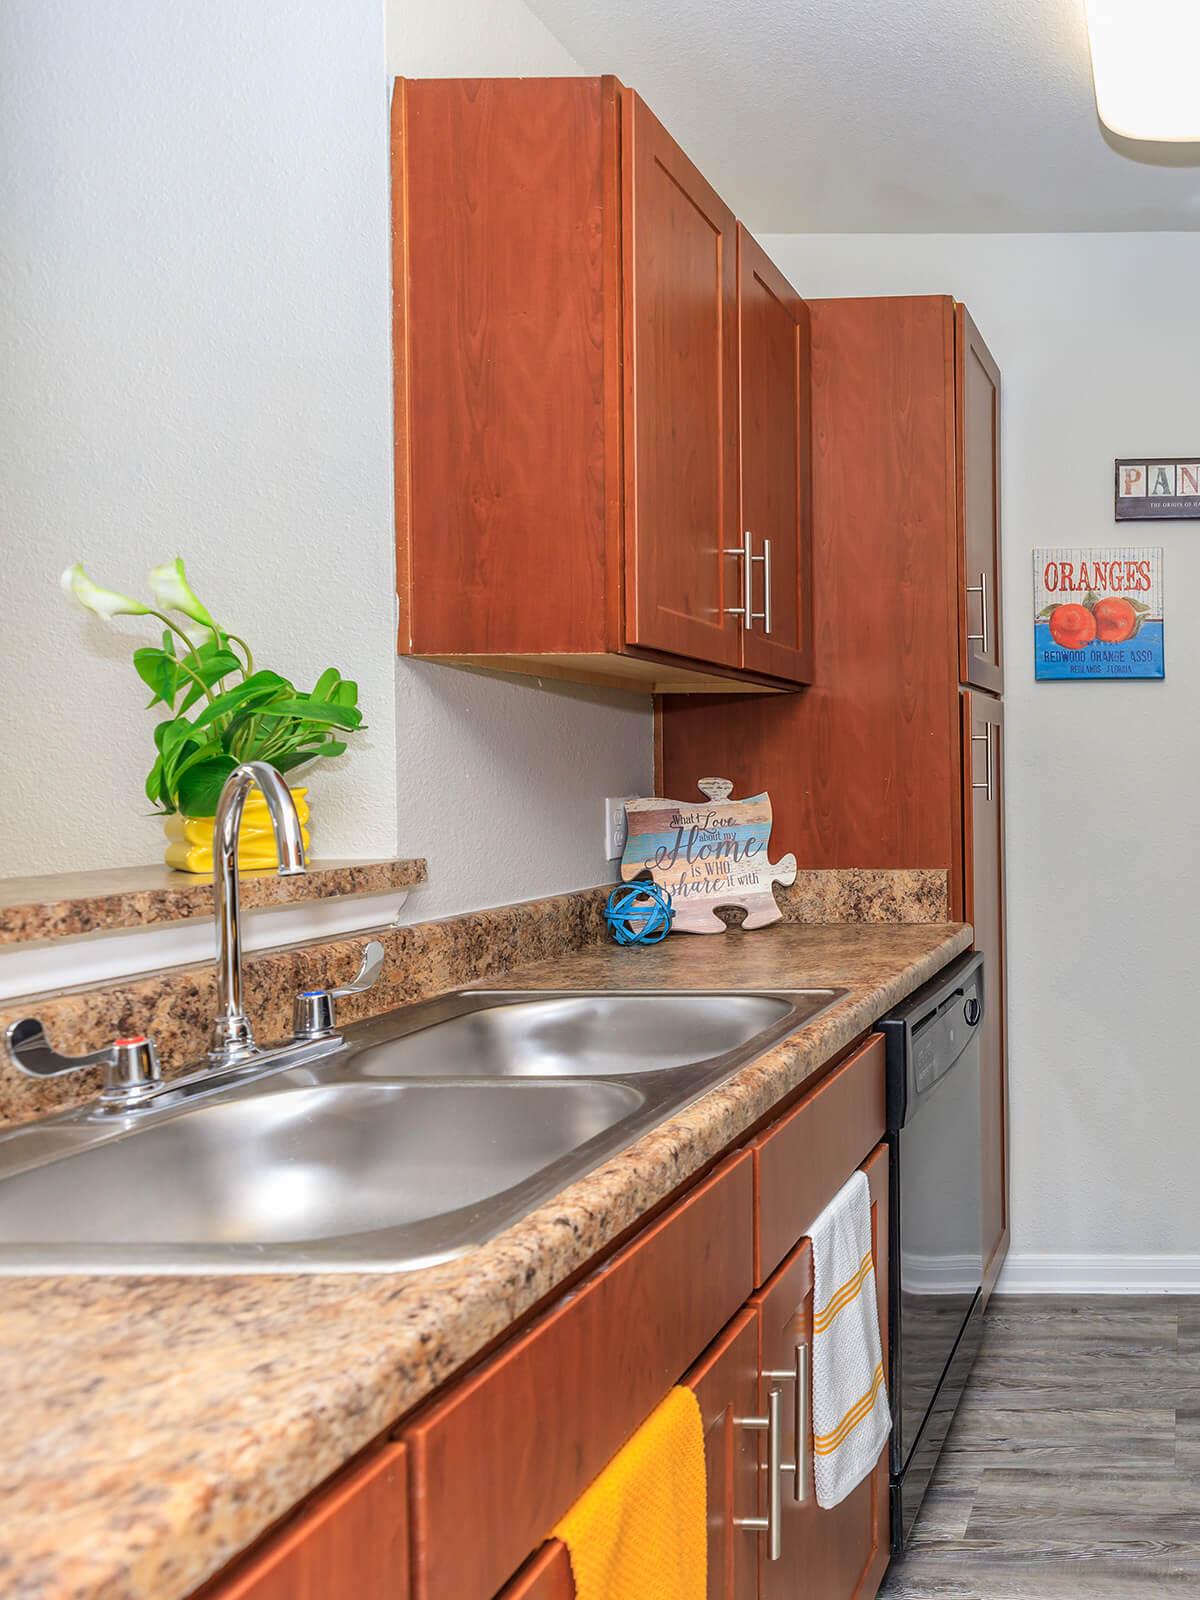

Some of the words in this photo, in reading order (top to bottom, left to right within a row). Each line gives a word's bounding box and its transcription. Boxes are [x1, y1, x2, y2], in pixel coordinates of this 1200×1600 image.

[1044, 561, 1151, 592] ORANGES
[1044, 650, 1085, 662] REDWOOD
[1090, 650, 1125, 661] ORANGE
[672, 813, 694, 826] What
[700, 811, 738, 834] Love
[644, 821, 764, 871] Home
[699, 832, 721, 842] about
[723, 831, 737, 841] my
[691, 864, 700, 877] is
[705, 861, 731, 876] WHO
[671, 872, 725, 897] share
[727, 876, 734, 887] it
[738, 872, 760, 886] with
